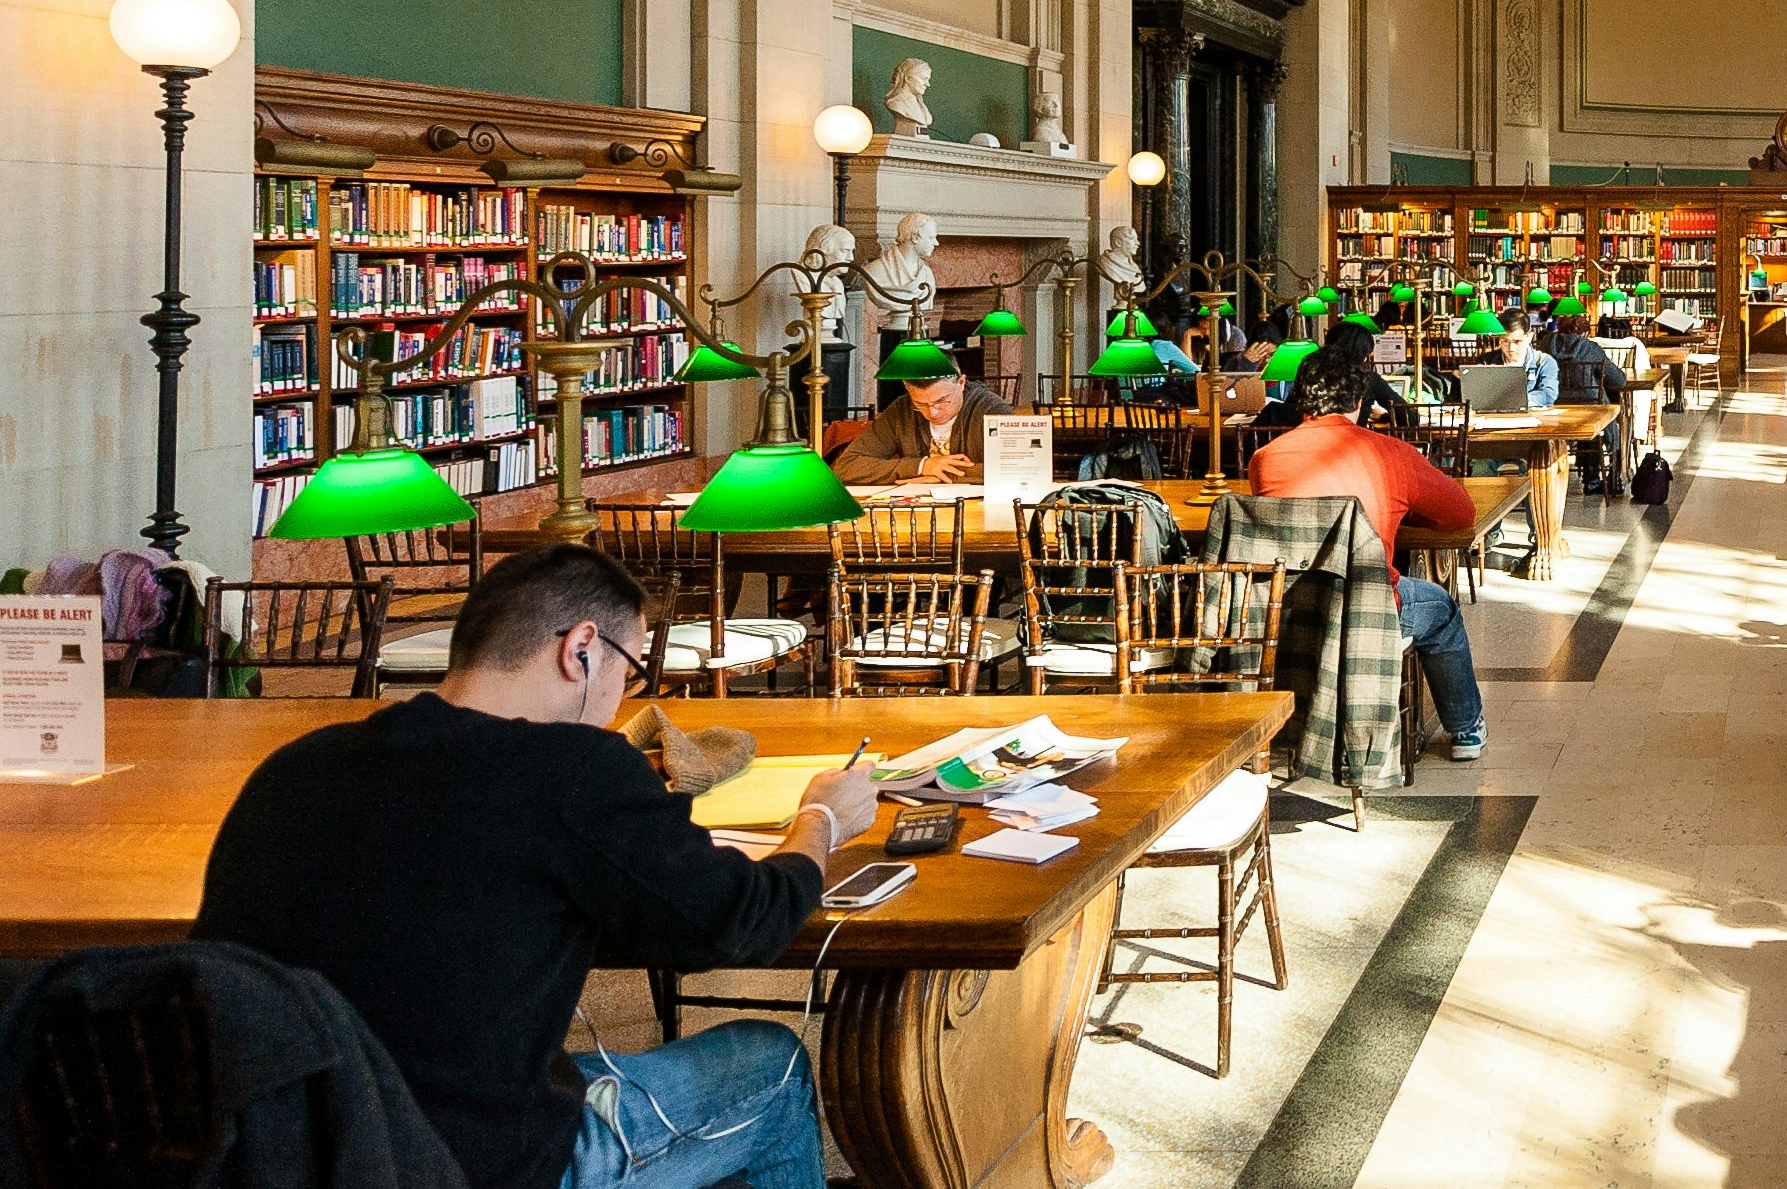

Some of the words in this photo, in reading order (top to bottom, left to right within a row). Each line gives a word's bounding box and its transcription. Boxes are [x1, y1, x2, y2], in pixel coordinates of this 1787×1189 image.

[0, 608, 39, 620] PLEASE
[43, 609, 56, 620] BE
[60, 609, 93, 621] ALERT
